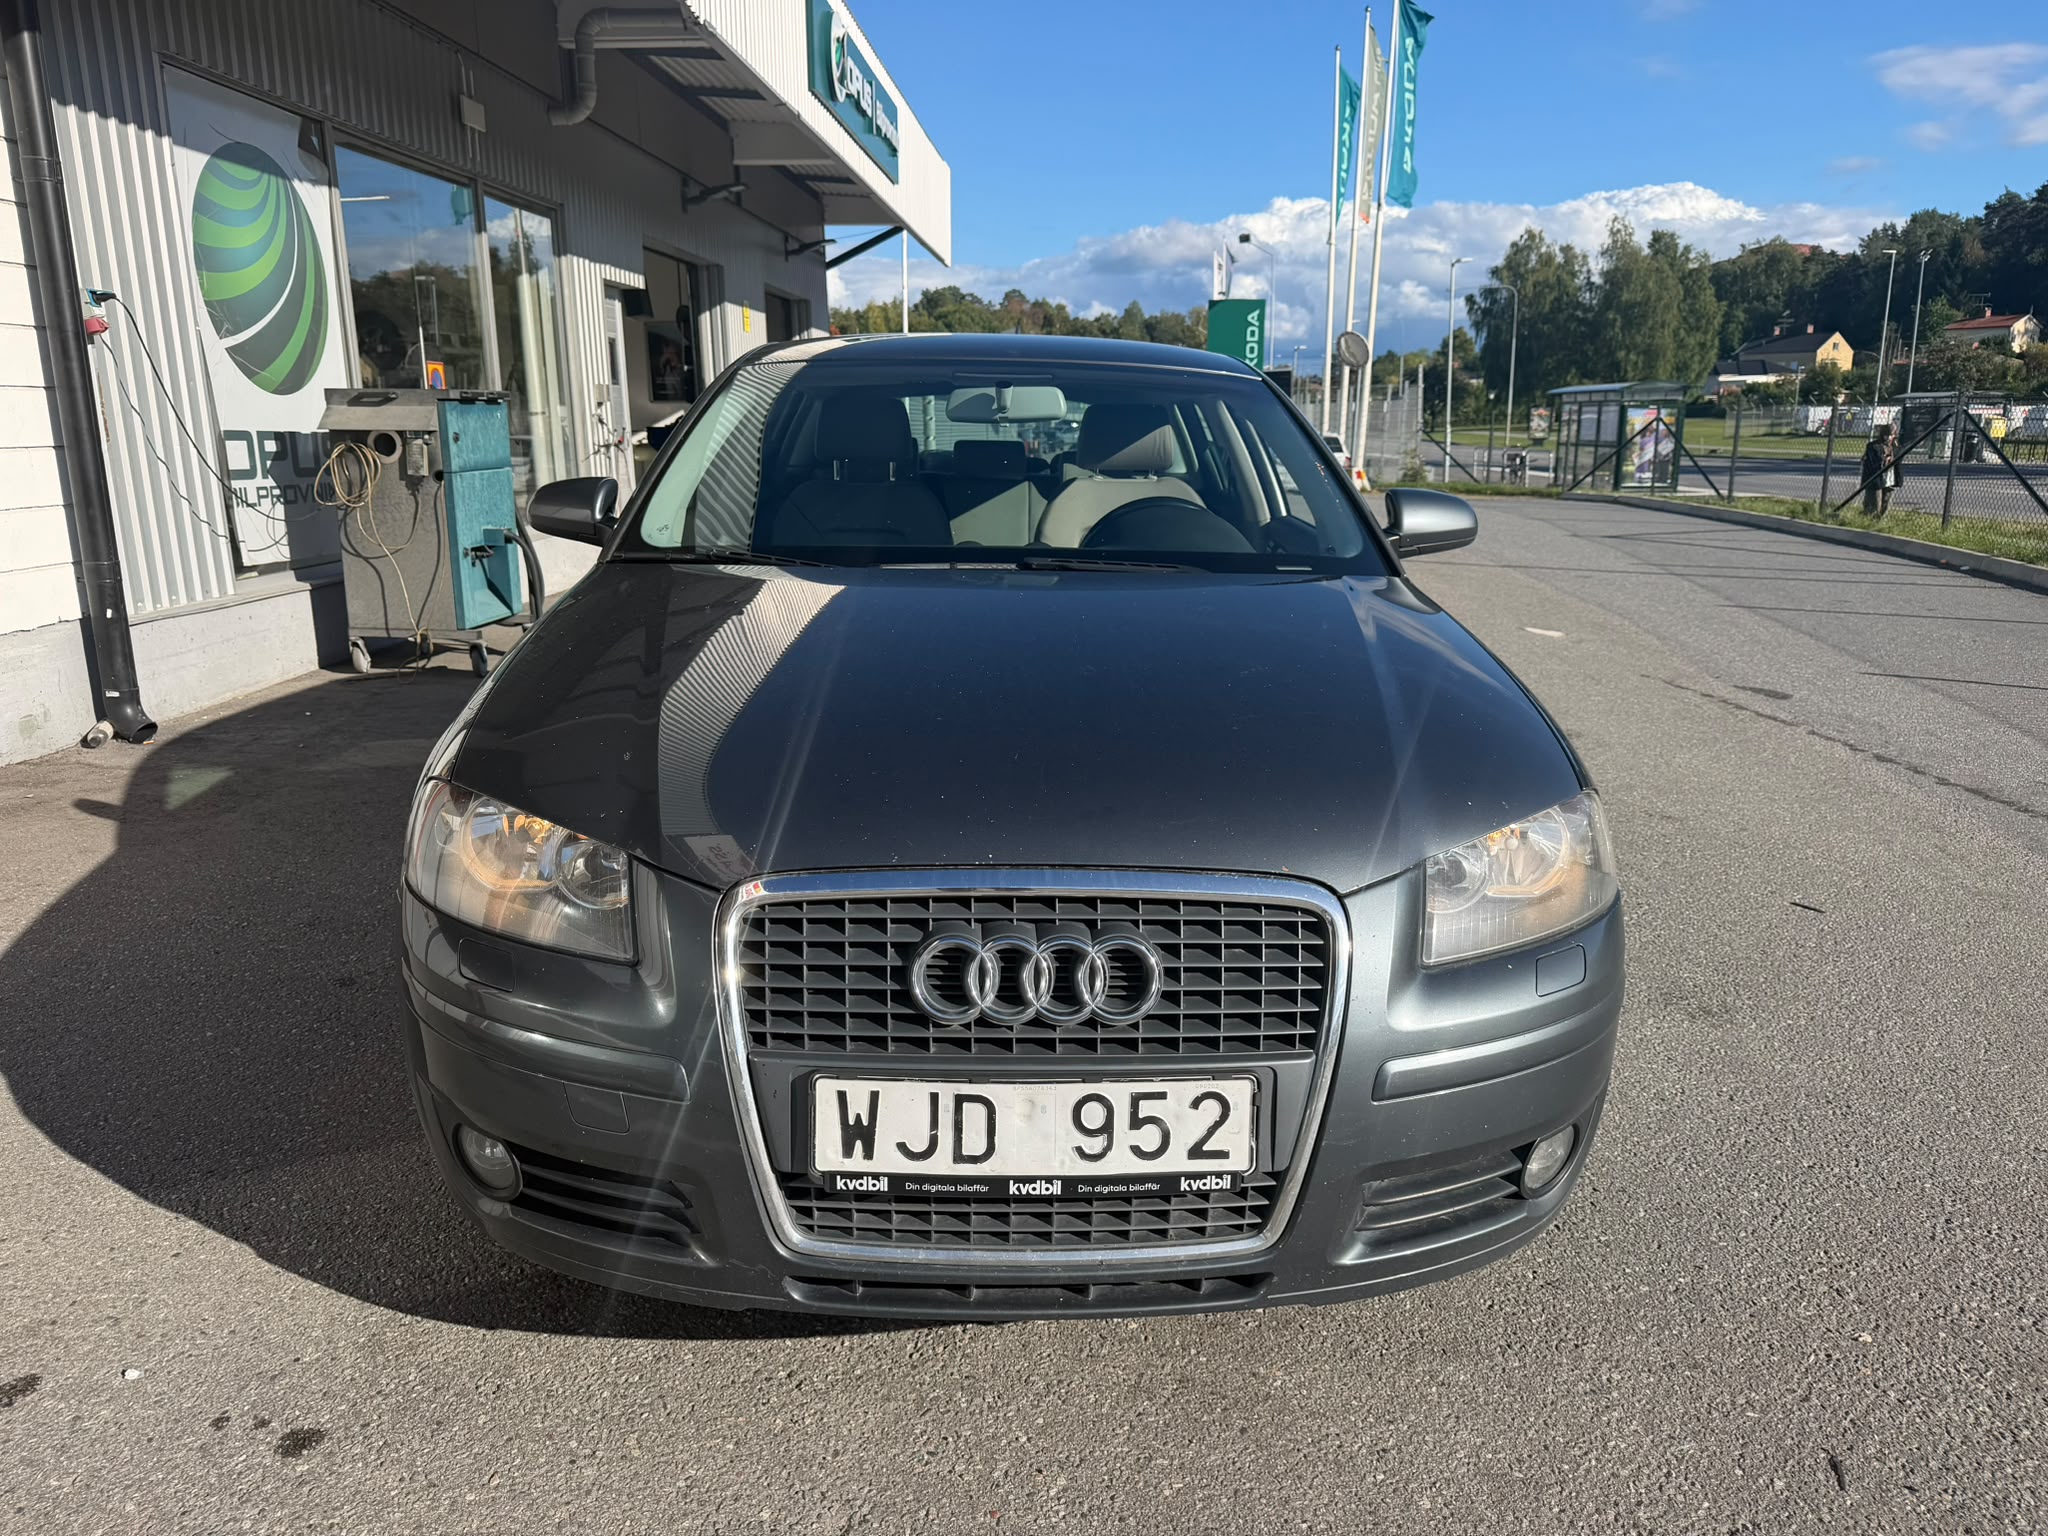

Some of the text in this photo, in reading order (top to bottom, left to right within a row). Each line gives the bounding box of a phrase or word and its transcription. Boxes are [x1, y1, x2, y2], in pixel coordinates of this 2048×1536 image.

[837, 1089, 1232, 1165] WJD 952
[836, 1174, 1231, 1195] kvdbil Din digitala bilaffär kvdbil Din digitala bilaffär kvdbil
